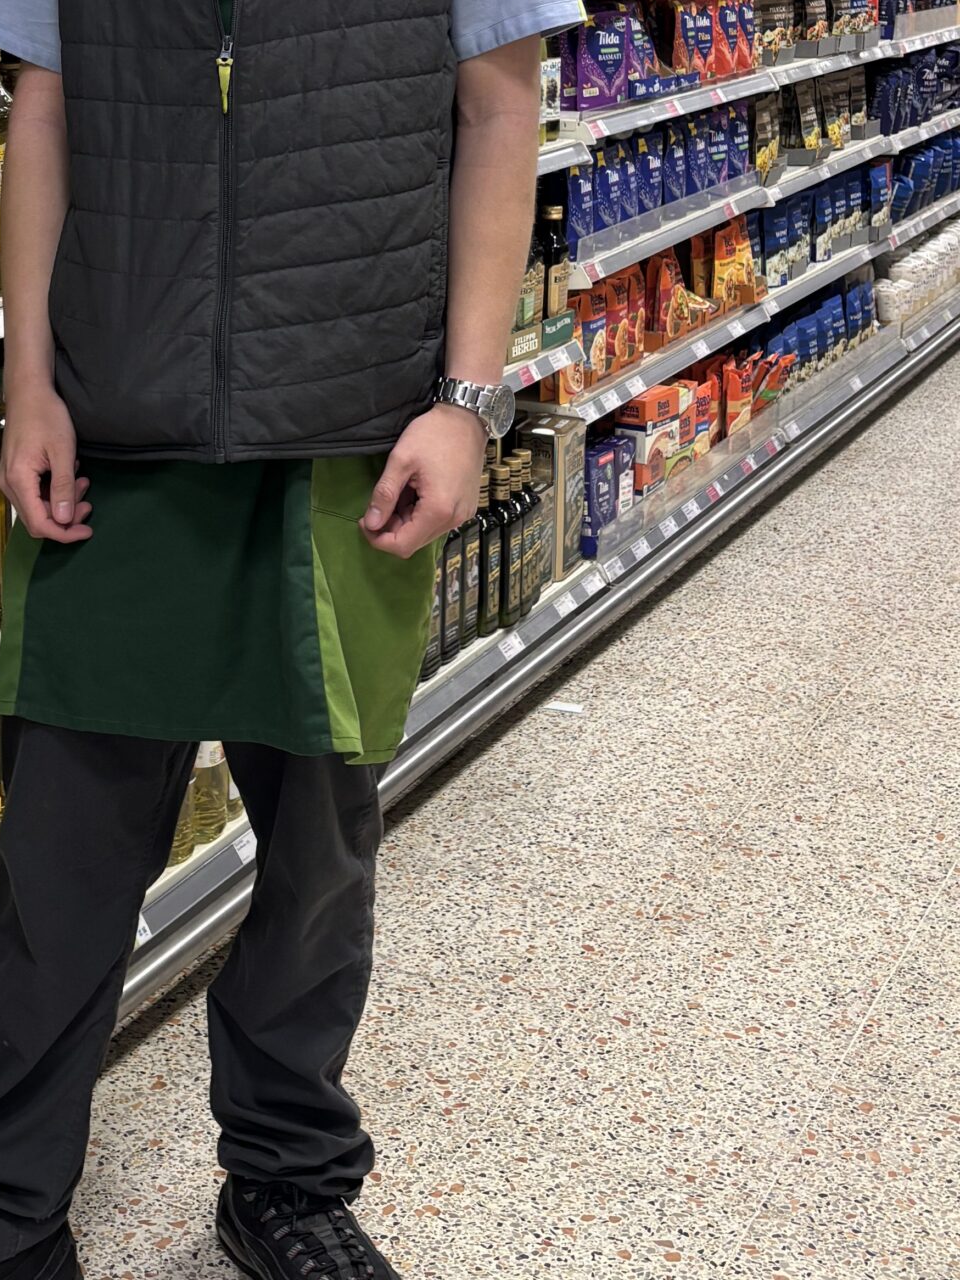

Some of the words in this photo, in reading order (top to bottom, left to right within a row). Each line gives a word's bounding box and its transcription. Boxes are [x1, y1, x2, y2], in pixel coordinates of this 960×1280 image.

[595, 30, 620, 46] Tilda
[598, 53, 622, 61] BASMATI
[512, 338, 538, 357] BERIO
